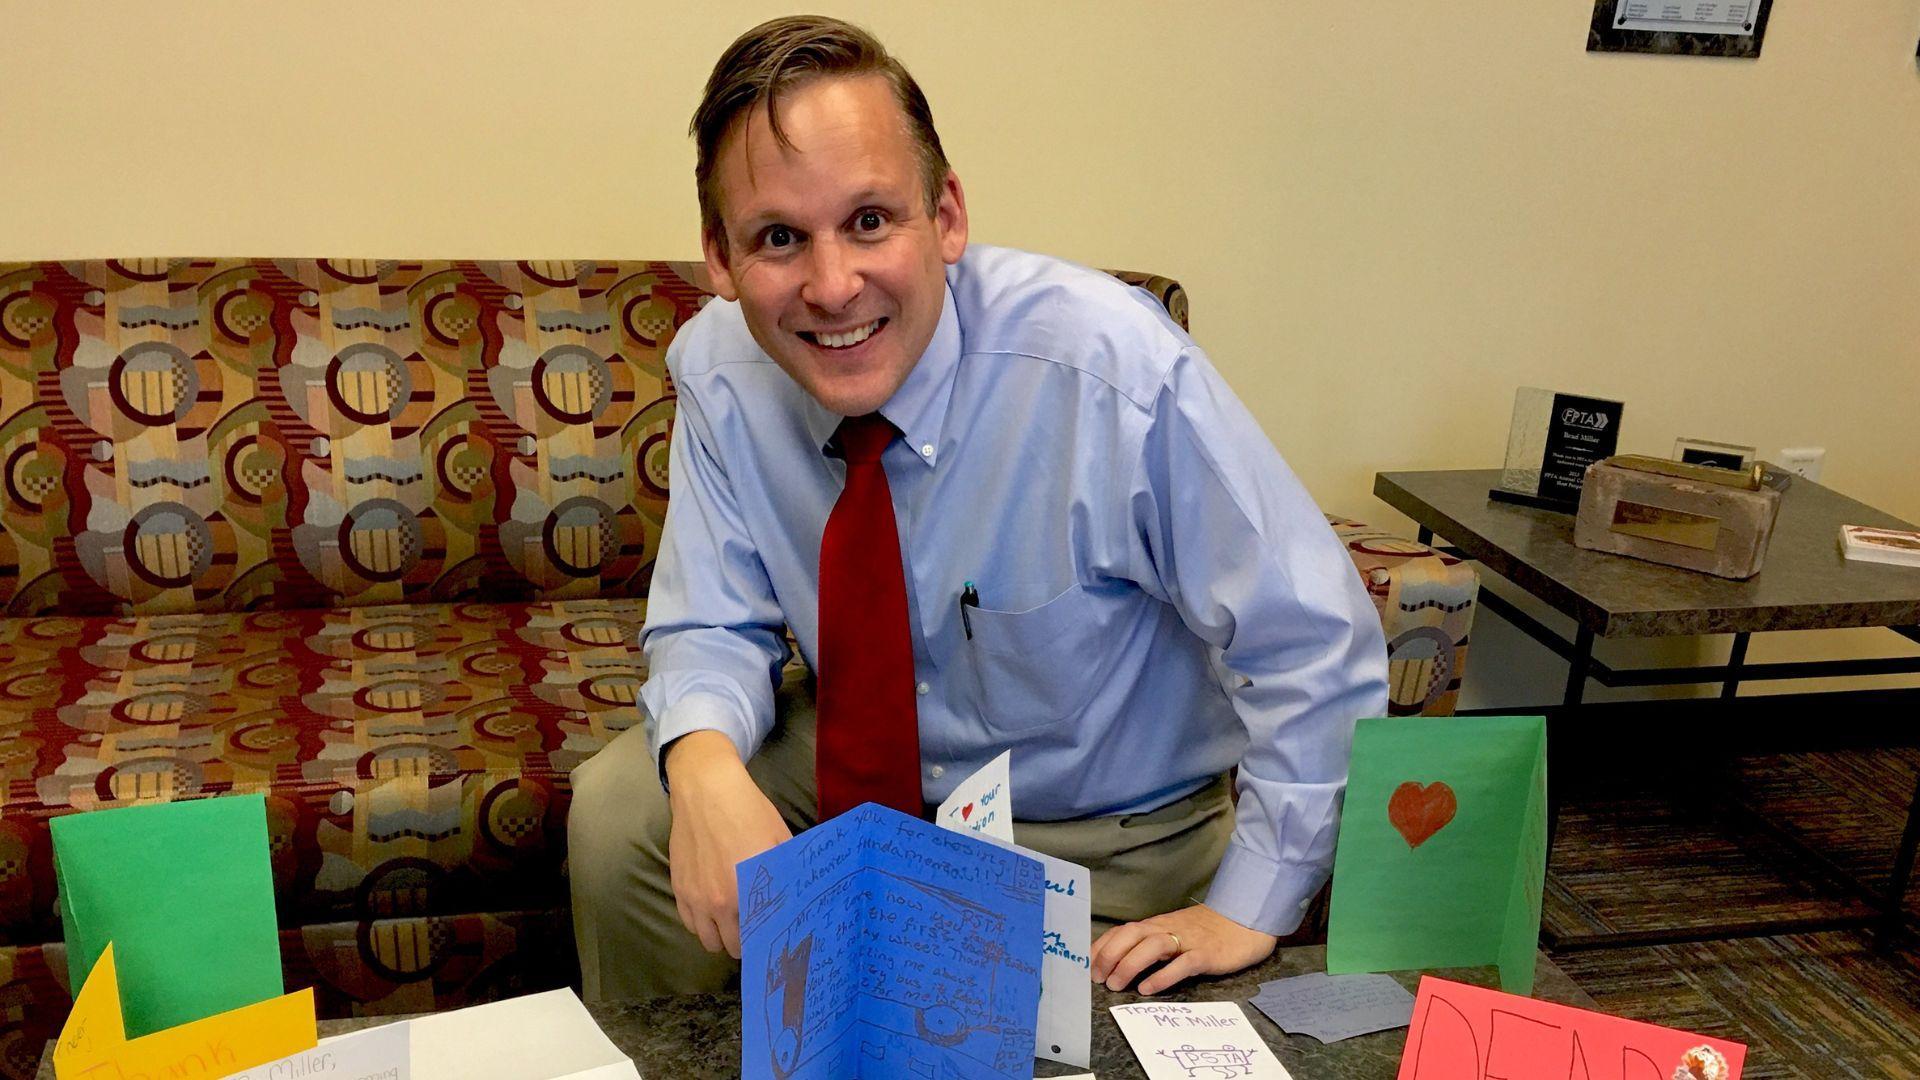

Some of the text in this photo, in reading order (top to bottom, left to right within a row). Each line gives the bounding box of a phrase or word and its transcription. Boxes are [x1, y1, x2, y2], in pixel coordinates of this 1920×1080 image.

[1562, 408, 1594, 425] FPTA
[1564, 432, 1600, 443] Brad Miller
[798, 830, 849, 868] Thank
[855, 809, 886, 831] you
[887, 889, 923, 911] how
[1117, 1005, 1193, 1016] Thanks
[1187, 1014, 1239, 1028] Miller
[1184, 1052, 1244, 1066] PSTA
